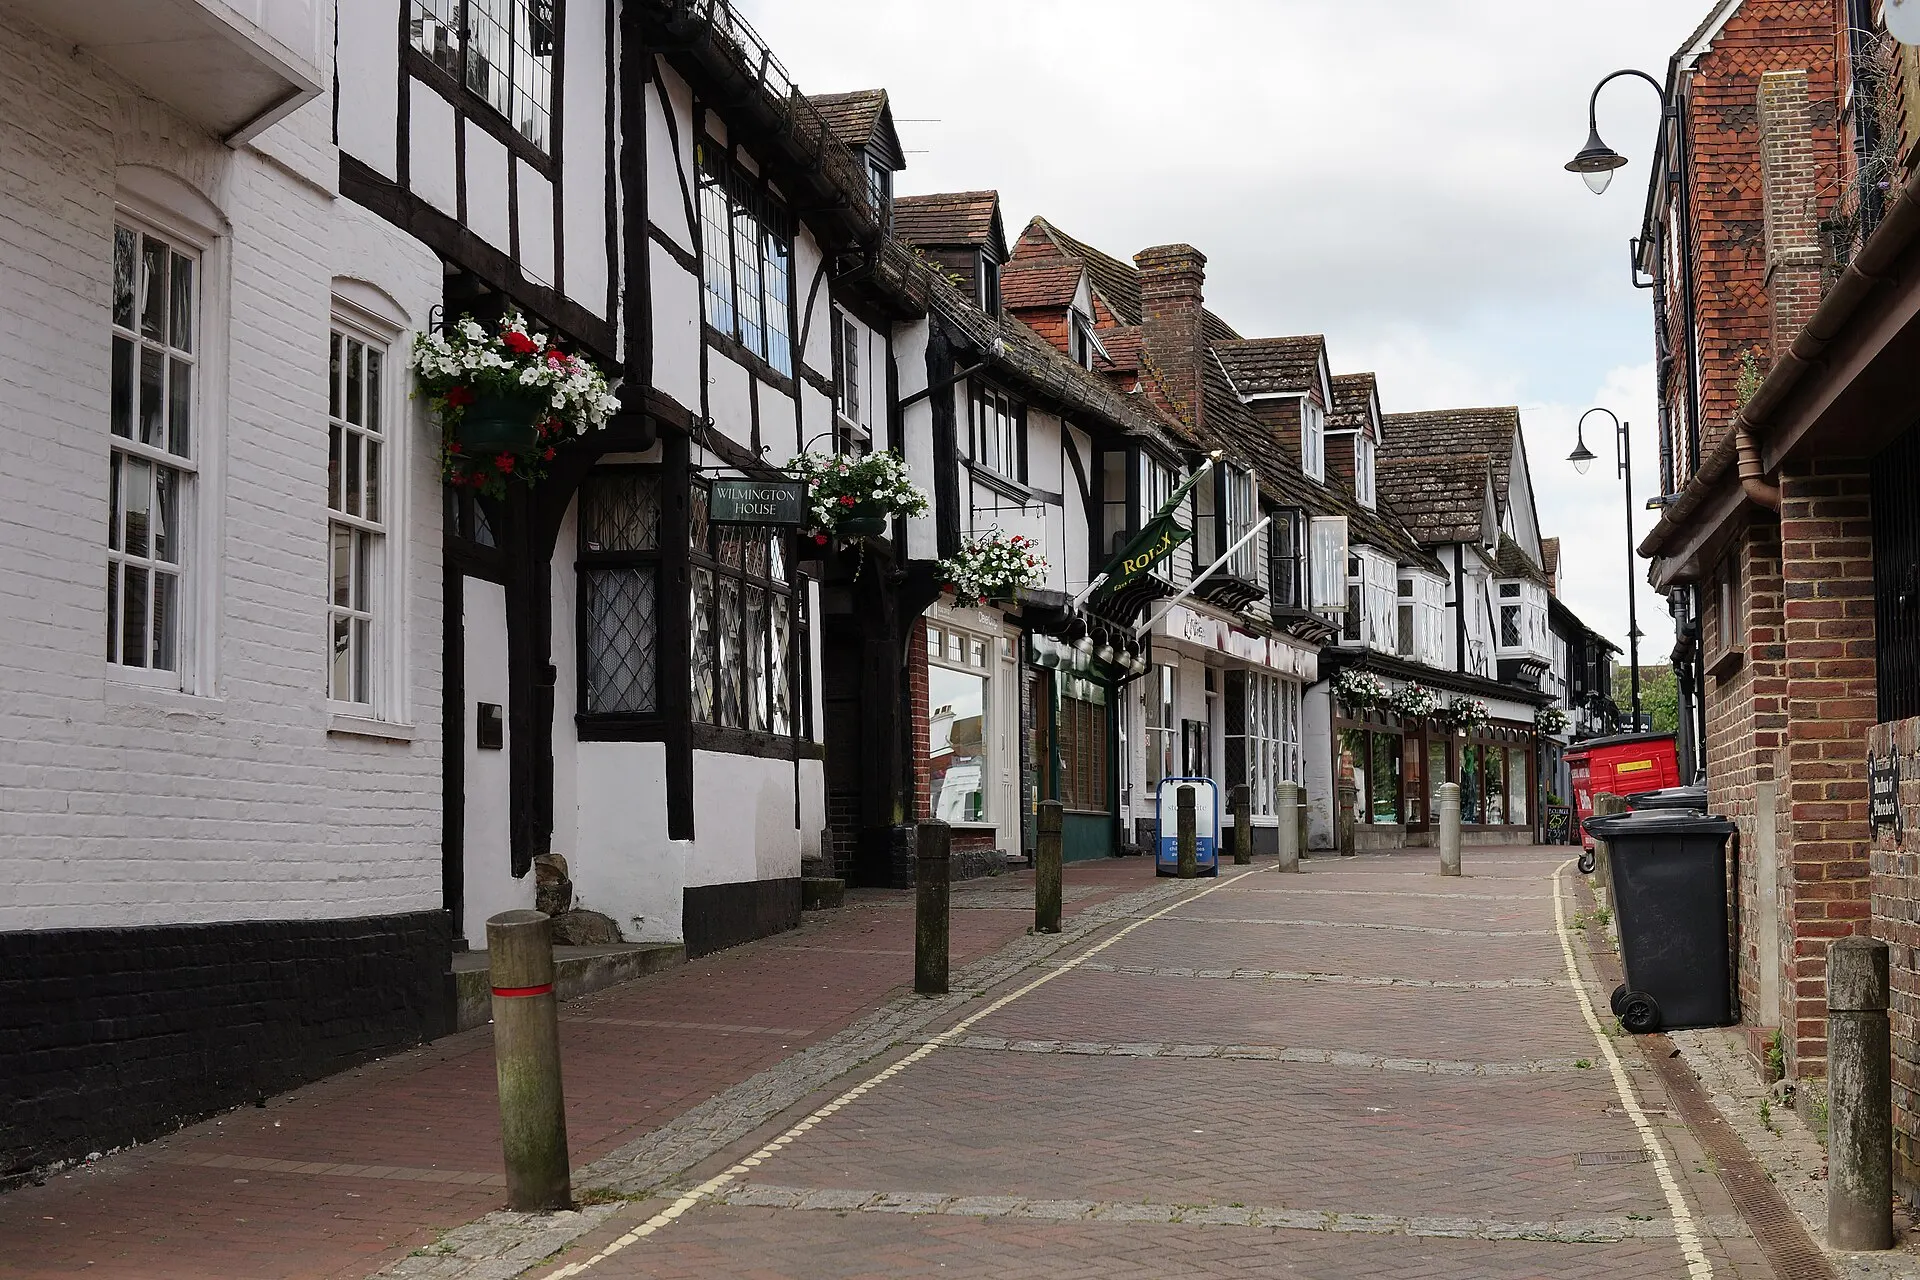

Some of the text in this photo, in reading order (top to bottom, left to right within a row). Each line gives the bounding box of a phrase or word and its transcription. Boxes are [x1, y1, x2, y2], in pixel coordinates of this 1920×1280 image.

[717, 487, 796, 501] WILMINGTON
[735, 502, 776, 515] HOUSE
[1549, 814, 1568, 825] 25%
